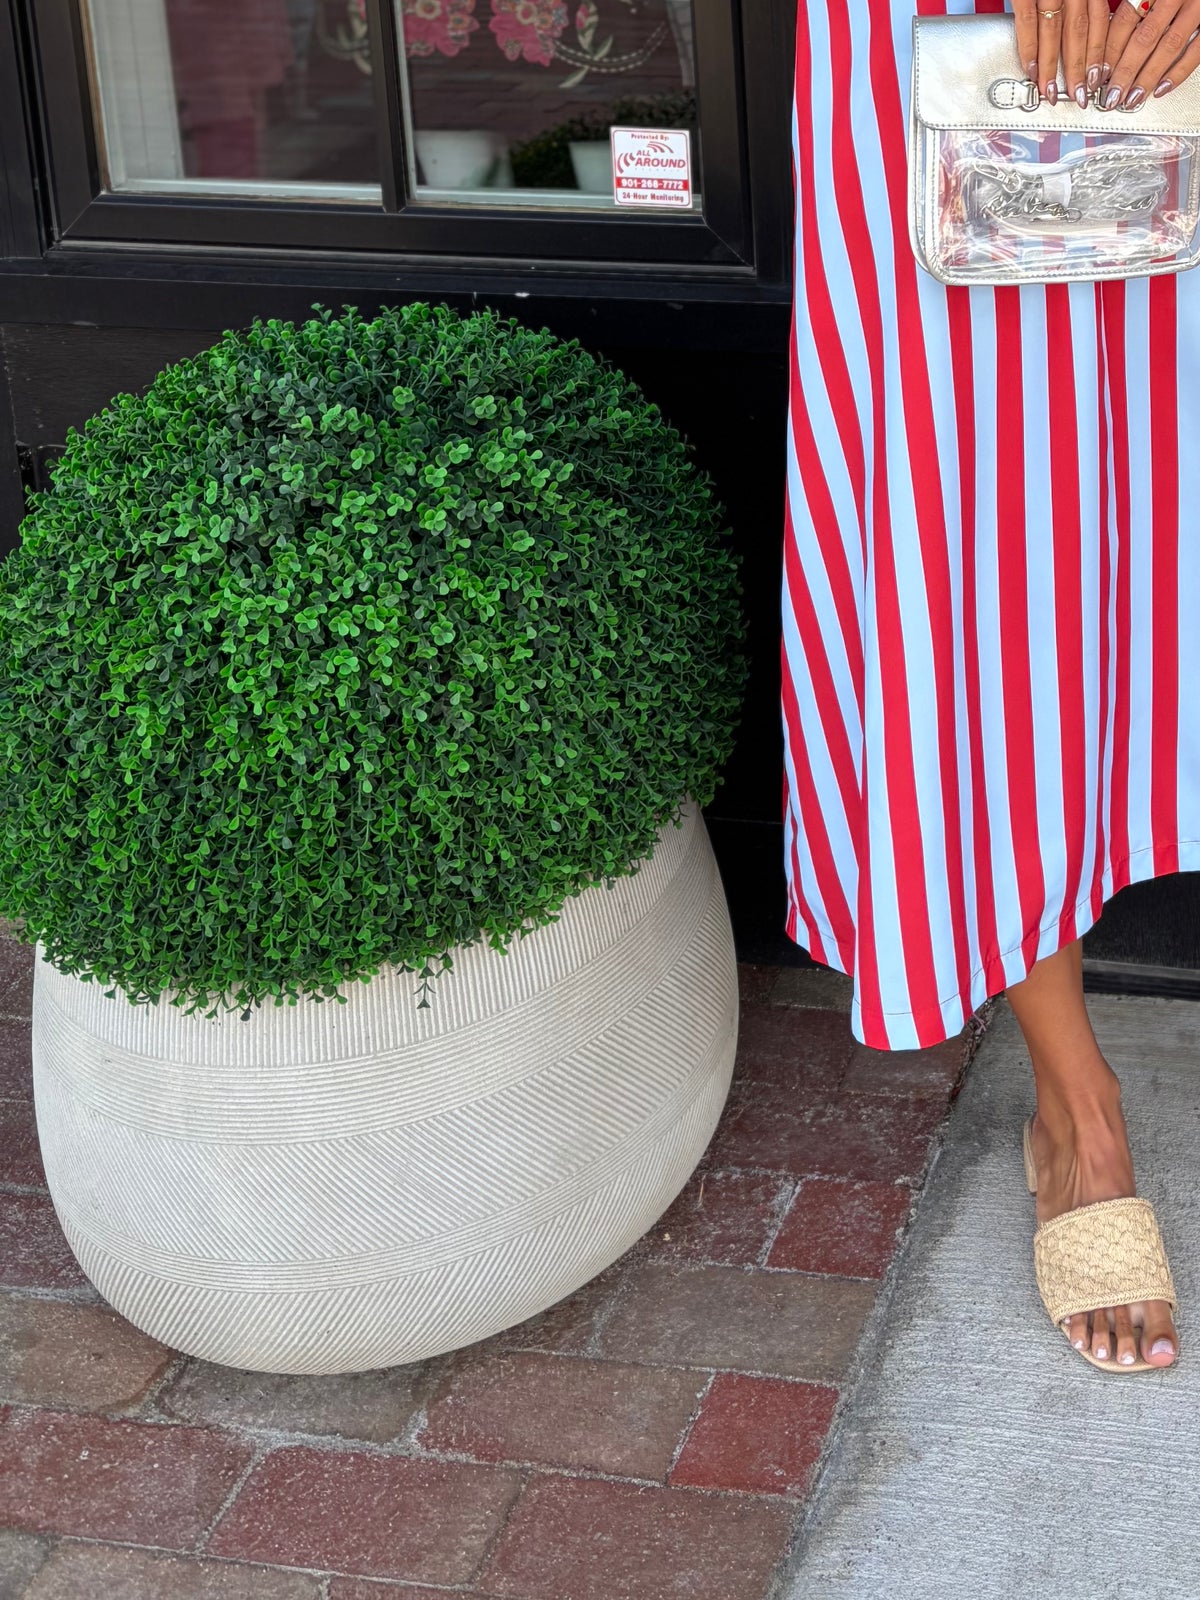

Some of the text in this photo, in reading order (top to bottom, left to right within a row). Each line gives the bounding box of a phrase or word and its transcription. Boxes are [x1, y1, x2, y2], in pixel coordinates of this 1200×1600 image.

[635, 158, 686, 168] AROUND
[621, 179, 684, 190] 901-268-7772
[650, 193, 684, 203] Monitoring
